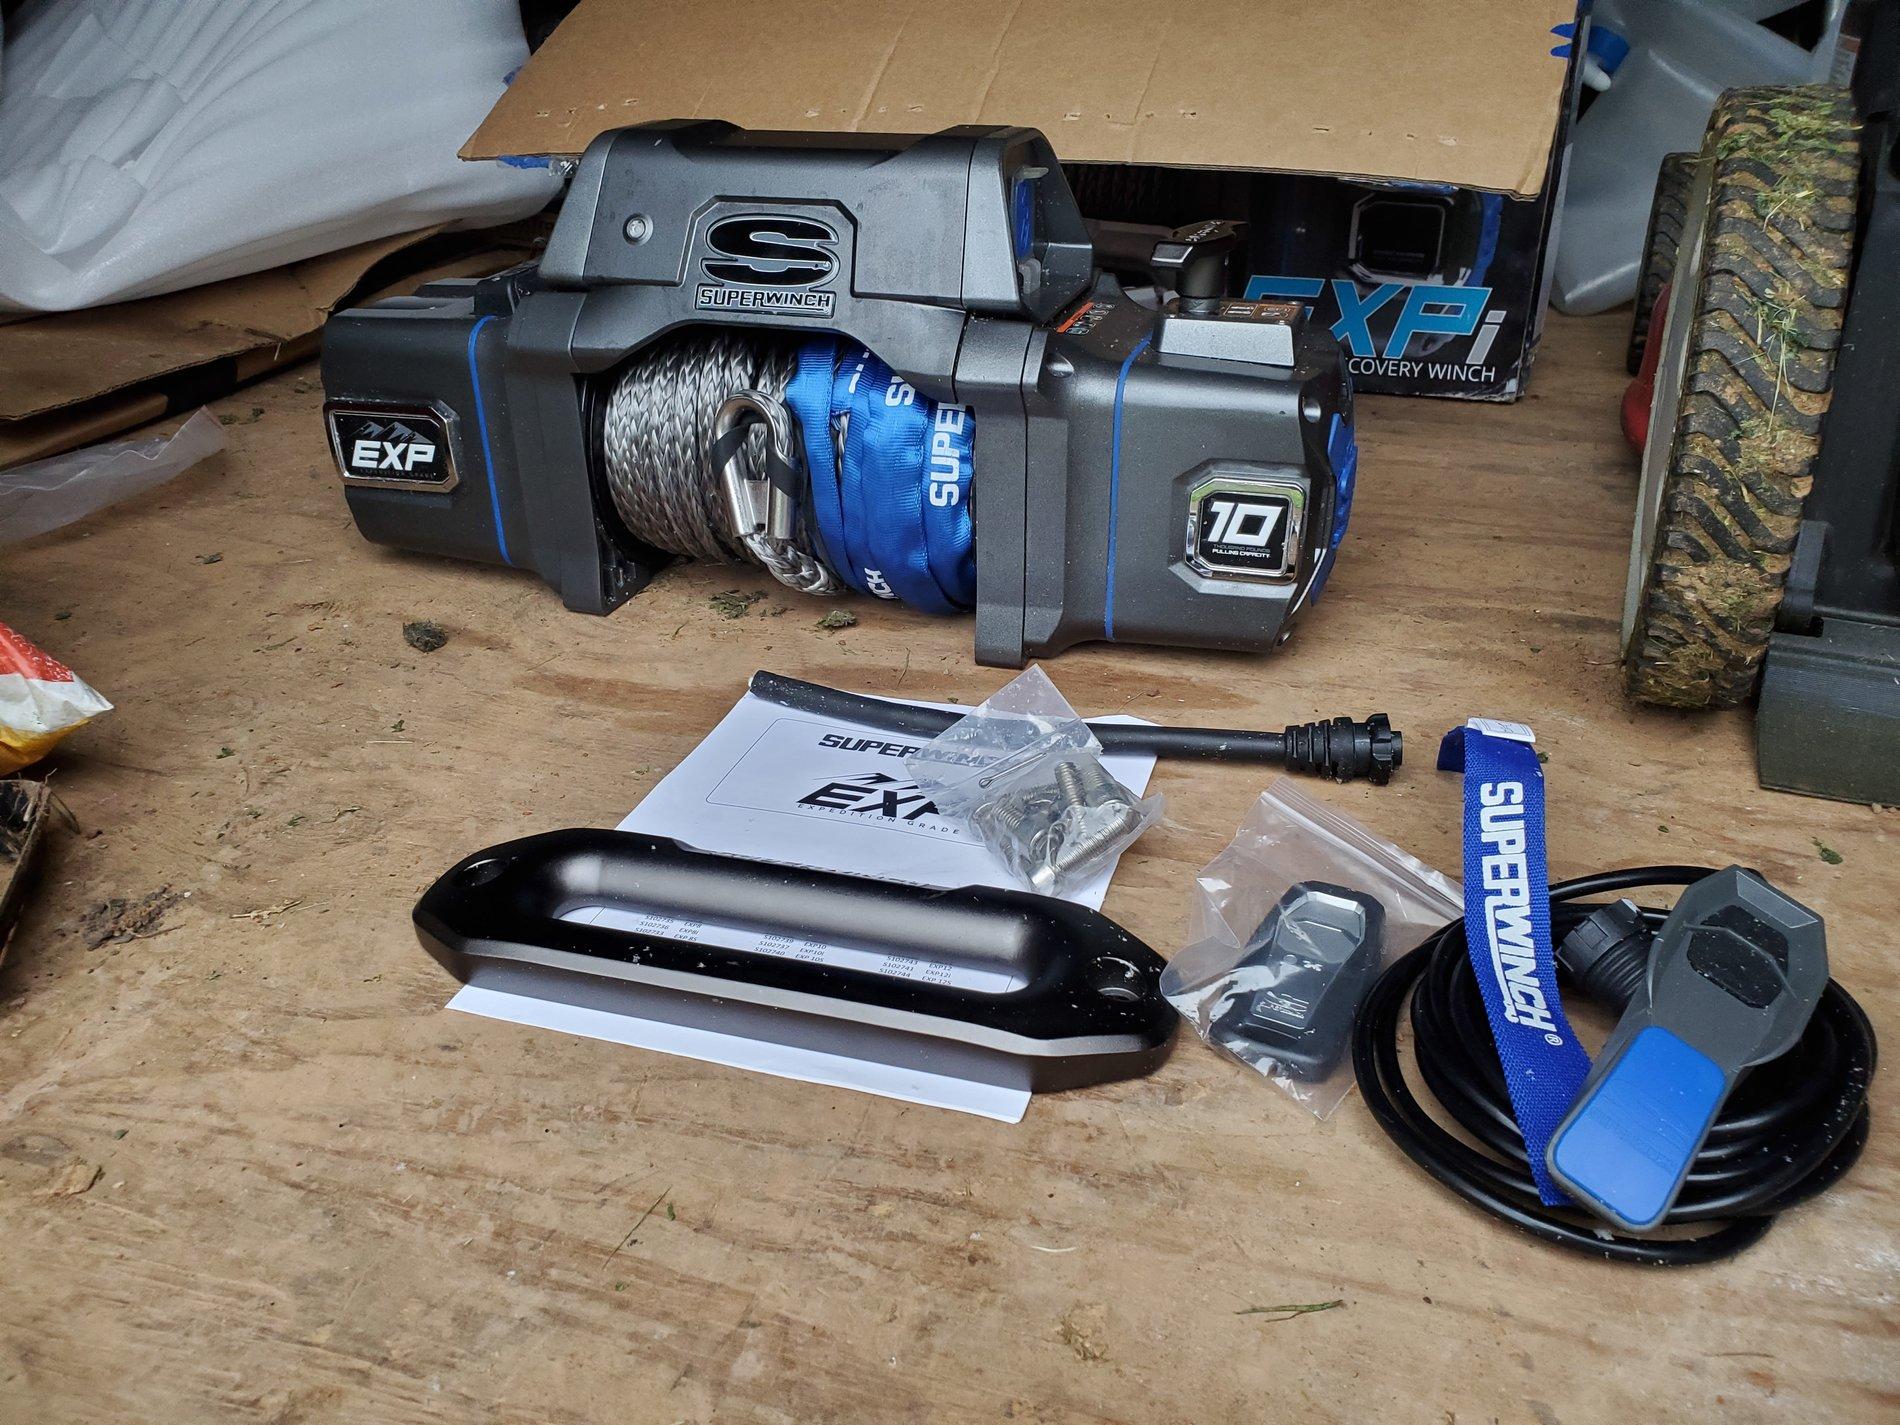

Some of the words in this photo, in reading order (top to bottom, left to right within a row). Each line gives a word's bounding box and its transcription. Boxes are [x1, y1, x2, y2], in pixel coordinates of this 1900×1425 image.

[700, 288, 831, 312] SUPERWINCH
[1344, 357, 1423, 379] COVERY
[1428, 363, 1495, 383] WINCH
[885, 376, 916, 407] S
[351, 439, 436, 472] EXP
[929, 402, 966, 507] SUPE
[1208, 501, 1283, 546] 10
[797, 803, 896, 823] EXPEDITION
[907, 820, 960, 834] GRADE
[803, 941, 827, 949] EXP10
[928, 963, 953, 971] EXP12
